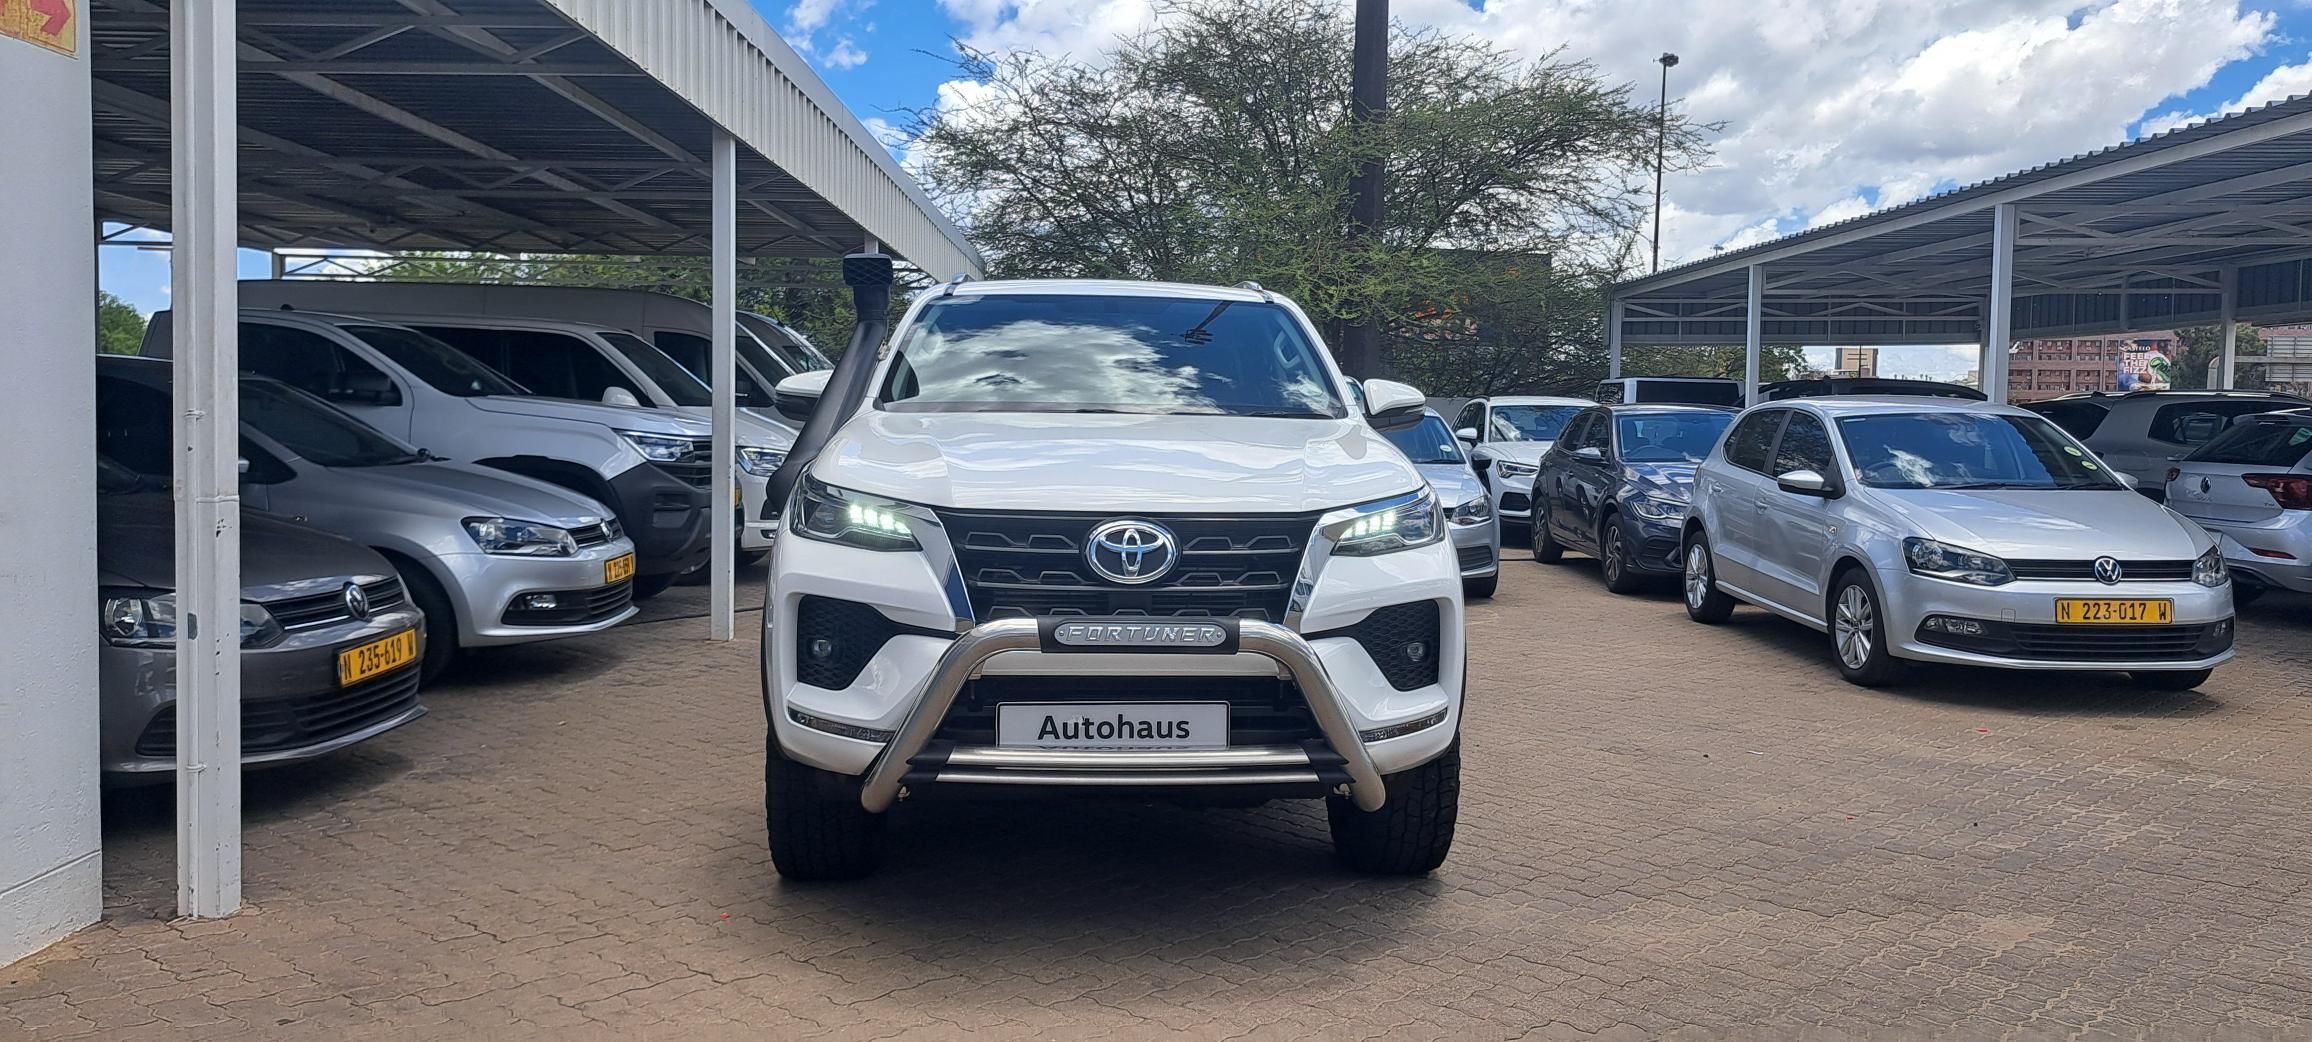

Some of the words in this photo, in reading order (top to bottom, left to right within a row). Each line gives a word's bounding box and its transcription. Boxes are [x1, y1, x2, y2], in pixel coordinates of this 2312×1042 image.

[2123, 352, 2149, 360] FEEL
[2061, 602, 2071, 620] N
[2082, 602, 2147, 621] 223-017
[2158, 602, 2167, 621] W
[1066, 625, 1218, 643] FORTUNER
[343, 653, 352, 681] N
[358, 637, 403, 675] 235-619
[1037, 713, 1190, 741] Autohaus
